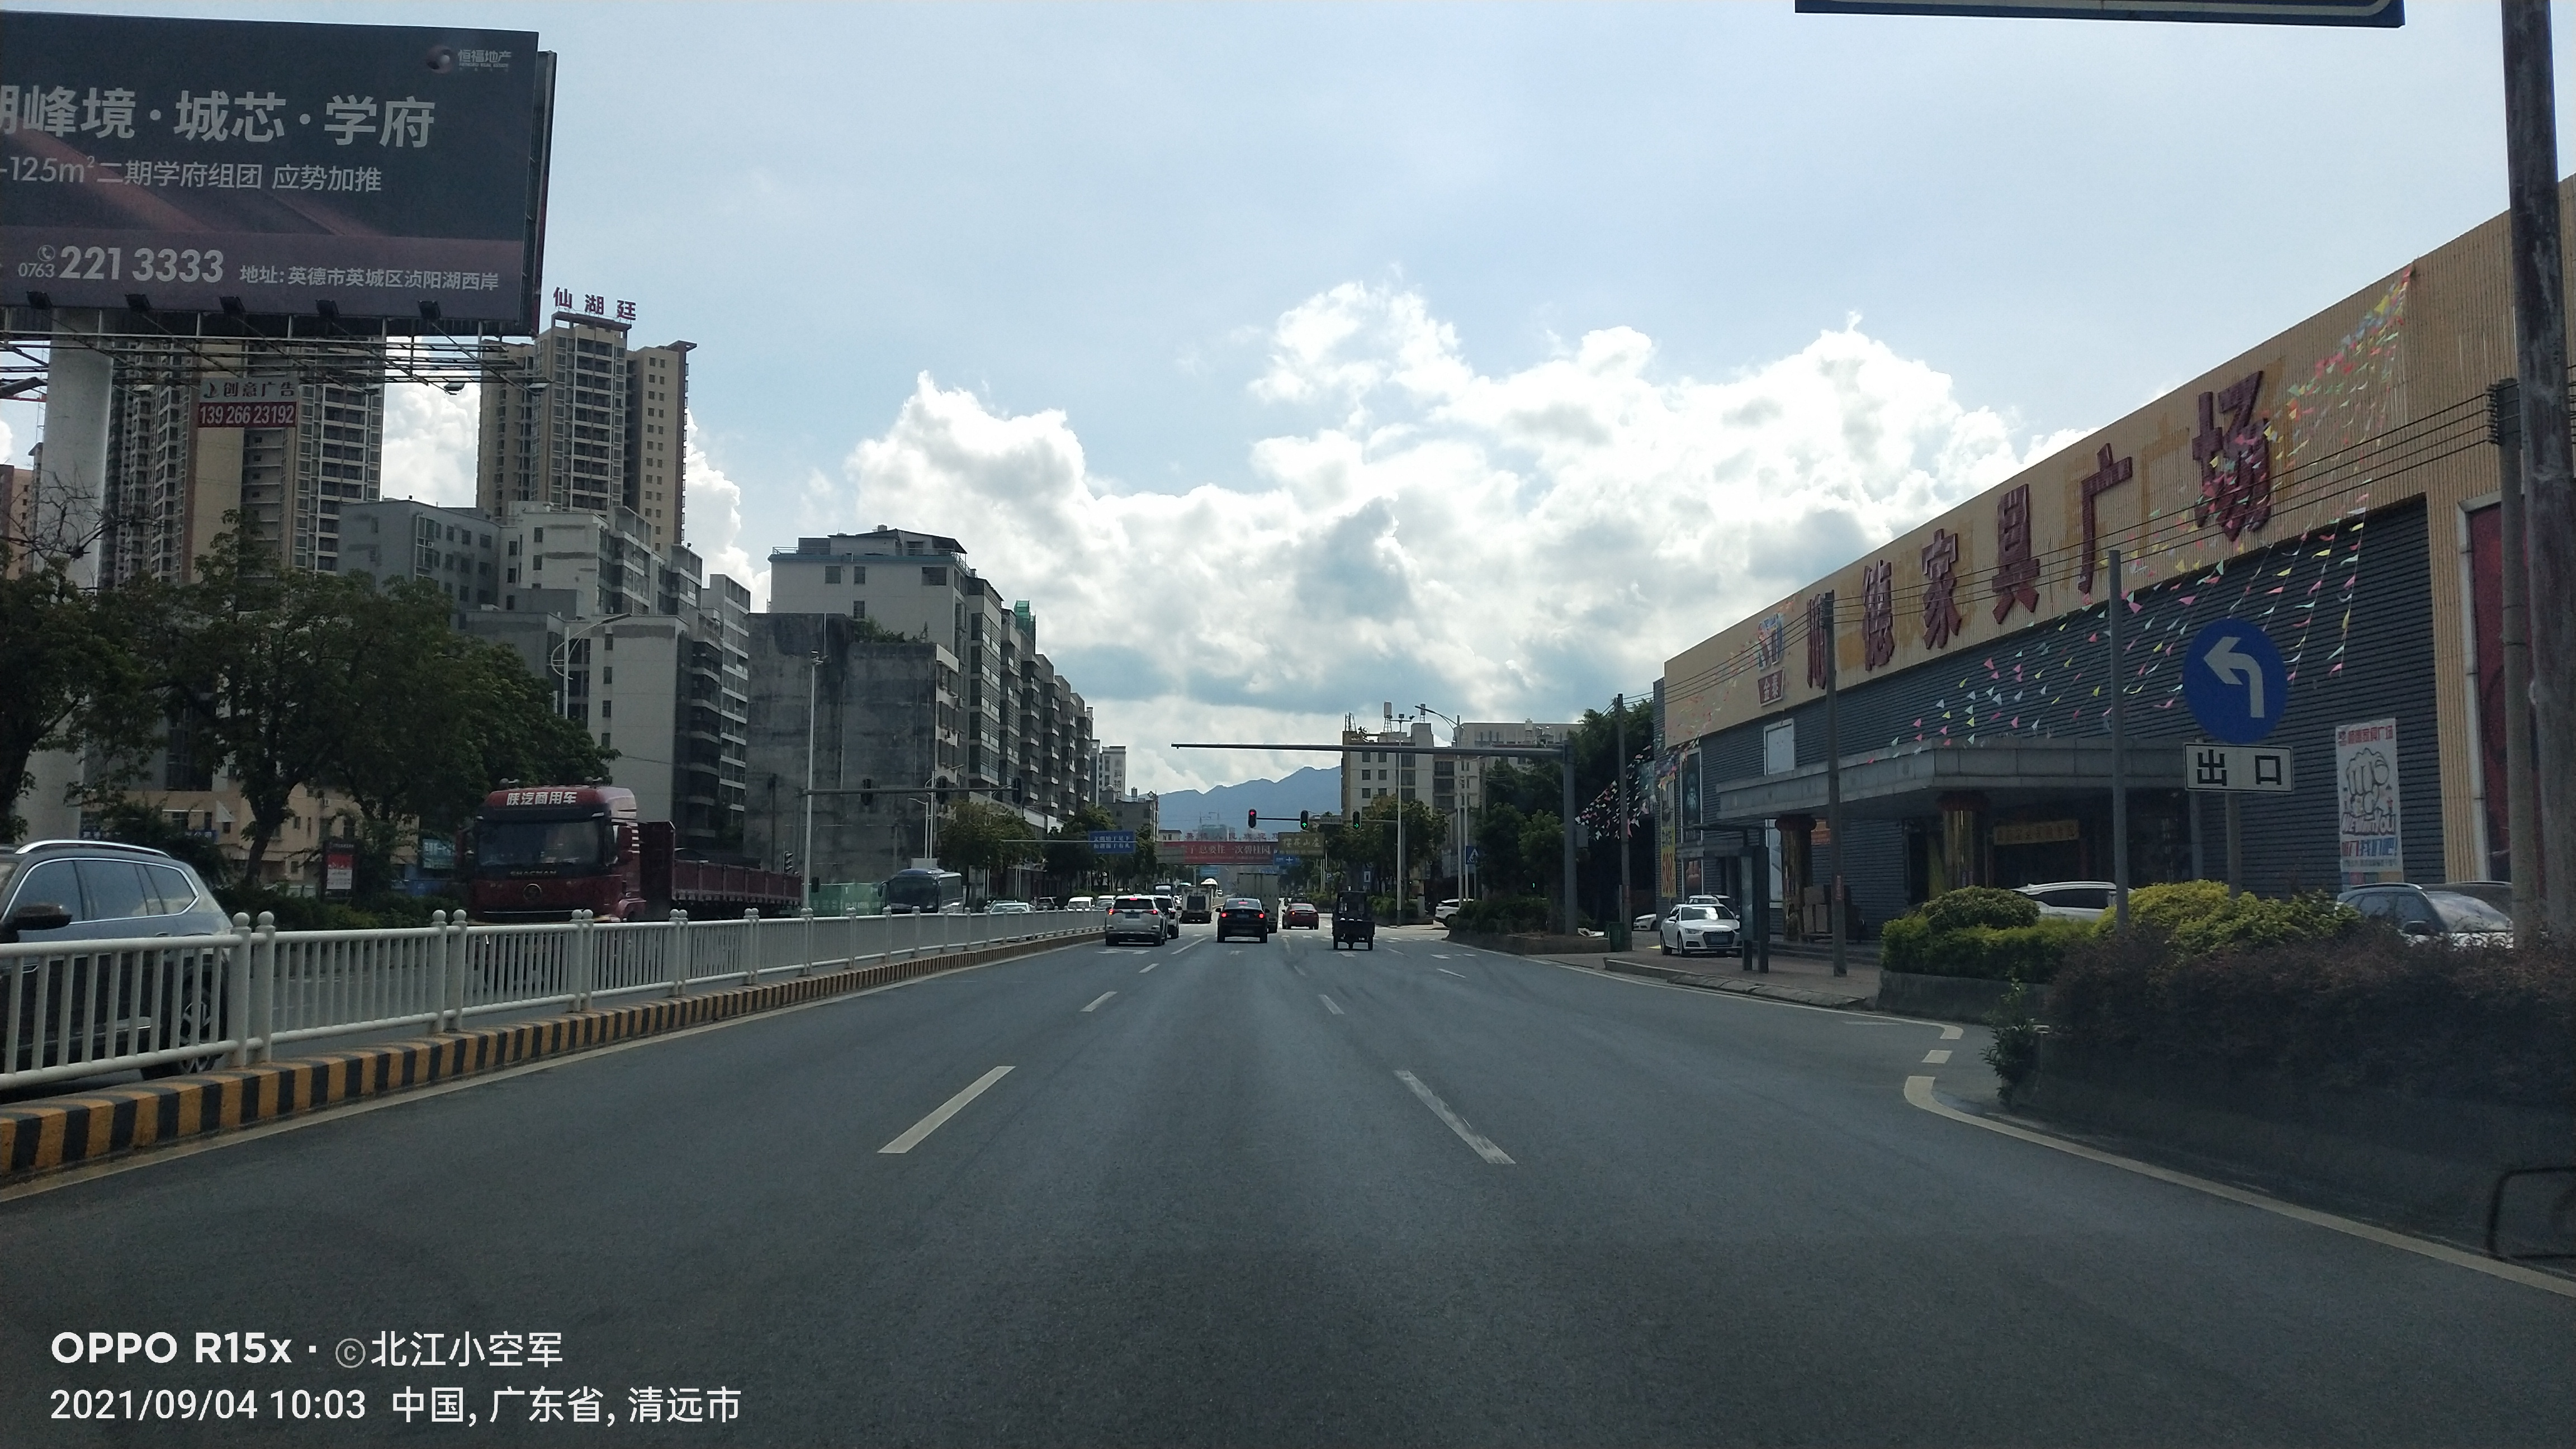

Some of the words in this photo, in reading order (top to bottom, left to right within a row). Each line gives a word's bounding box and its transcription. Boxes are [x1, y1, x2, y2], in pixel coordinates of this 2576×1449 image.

[458, 49, 512, 63] 恒福地产
[272, 164, 382, 192] 应势加推
[18, 263, 55, 278] 0763
[58, 245, 121, 280] 221
[132, 248, 224, 283] 3333
[553, 286, 636, 320] 仙湖廷
[224, 381, 295, 397] 创意广告
[200, 405, 224, 424] 139
[226, 405, 251, 424] 266
[253, 405, 295, 424] 23192
[2197, 749, 2282, 786] 出口
[506, 791, 577, 806] 陕汽商用车
